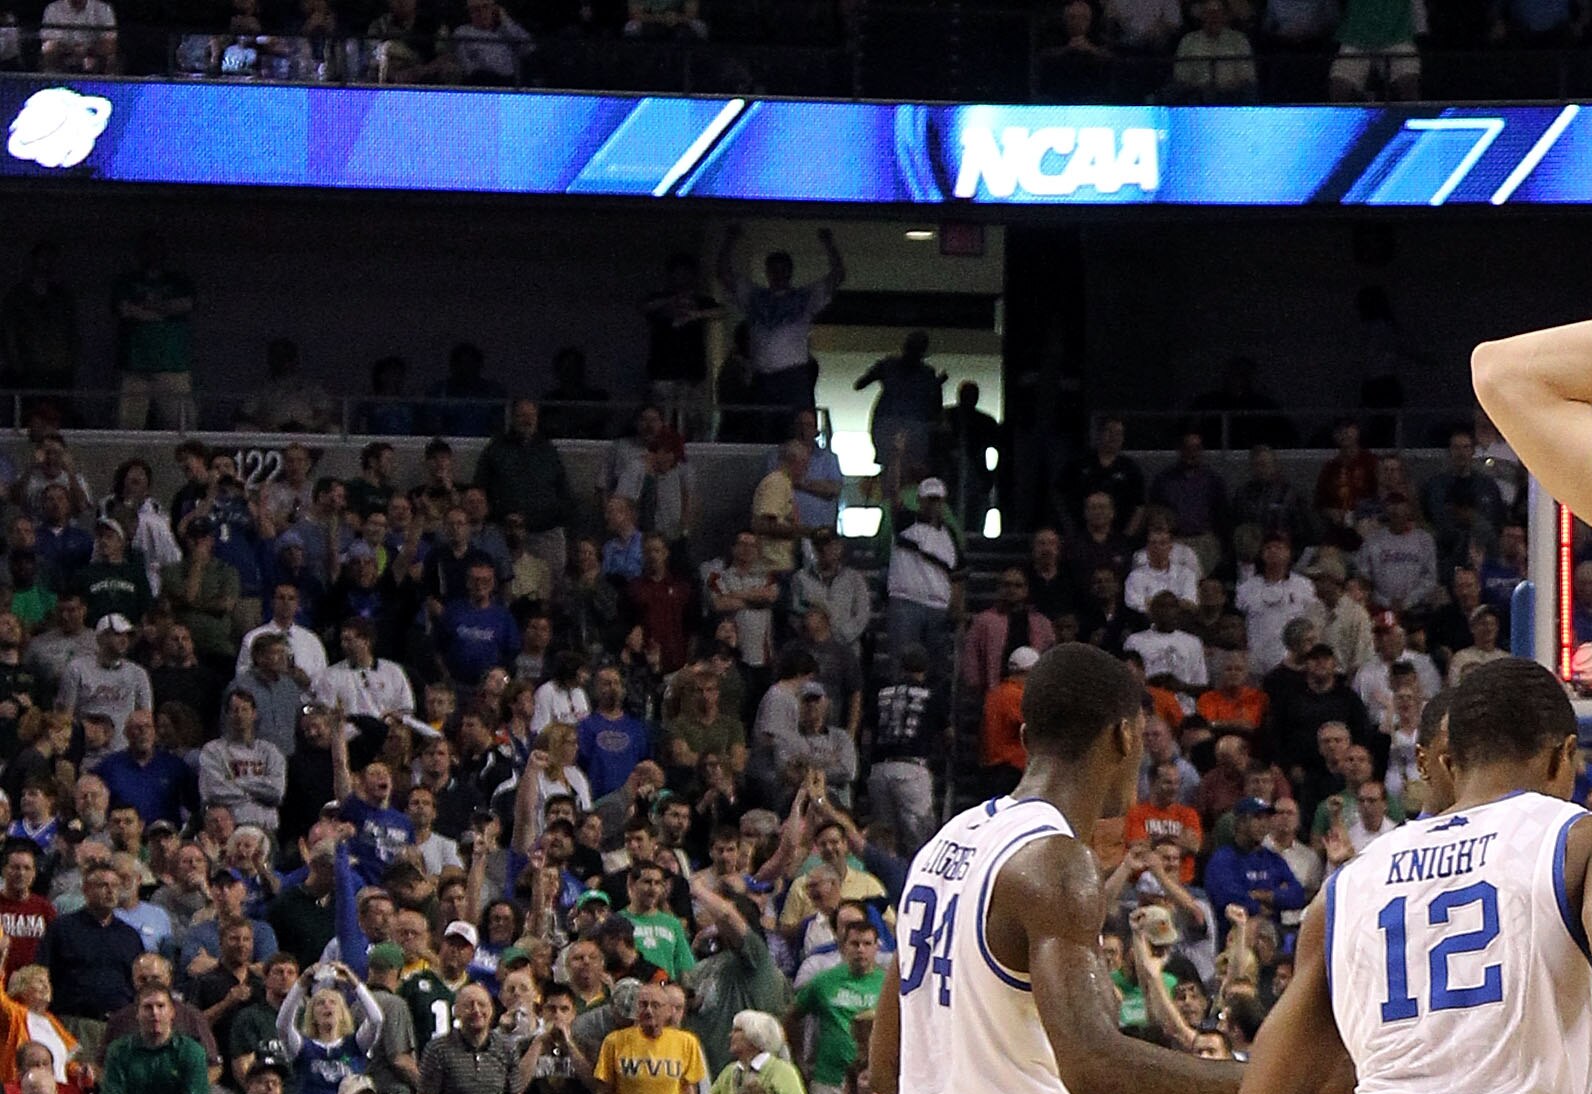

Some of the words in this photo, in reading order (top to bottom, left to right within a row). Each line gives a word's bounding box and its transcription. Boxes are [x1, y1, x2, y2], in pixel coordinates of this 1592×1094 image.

[953, 127, 1157, 198] NCAA
[234, 450, 283, 490] 122
[1385, 832, 1498, 885] KNIGHT
[900, 885, 960, 1007] 34
[1378, 880, 1503, 1024] 12
[620, 1057, 682, 1079] WVU
